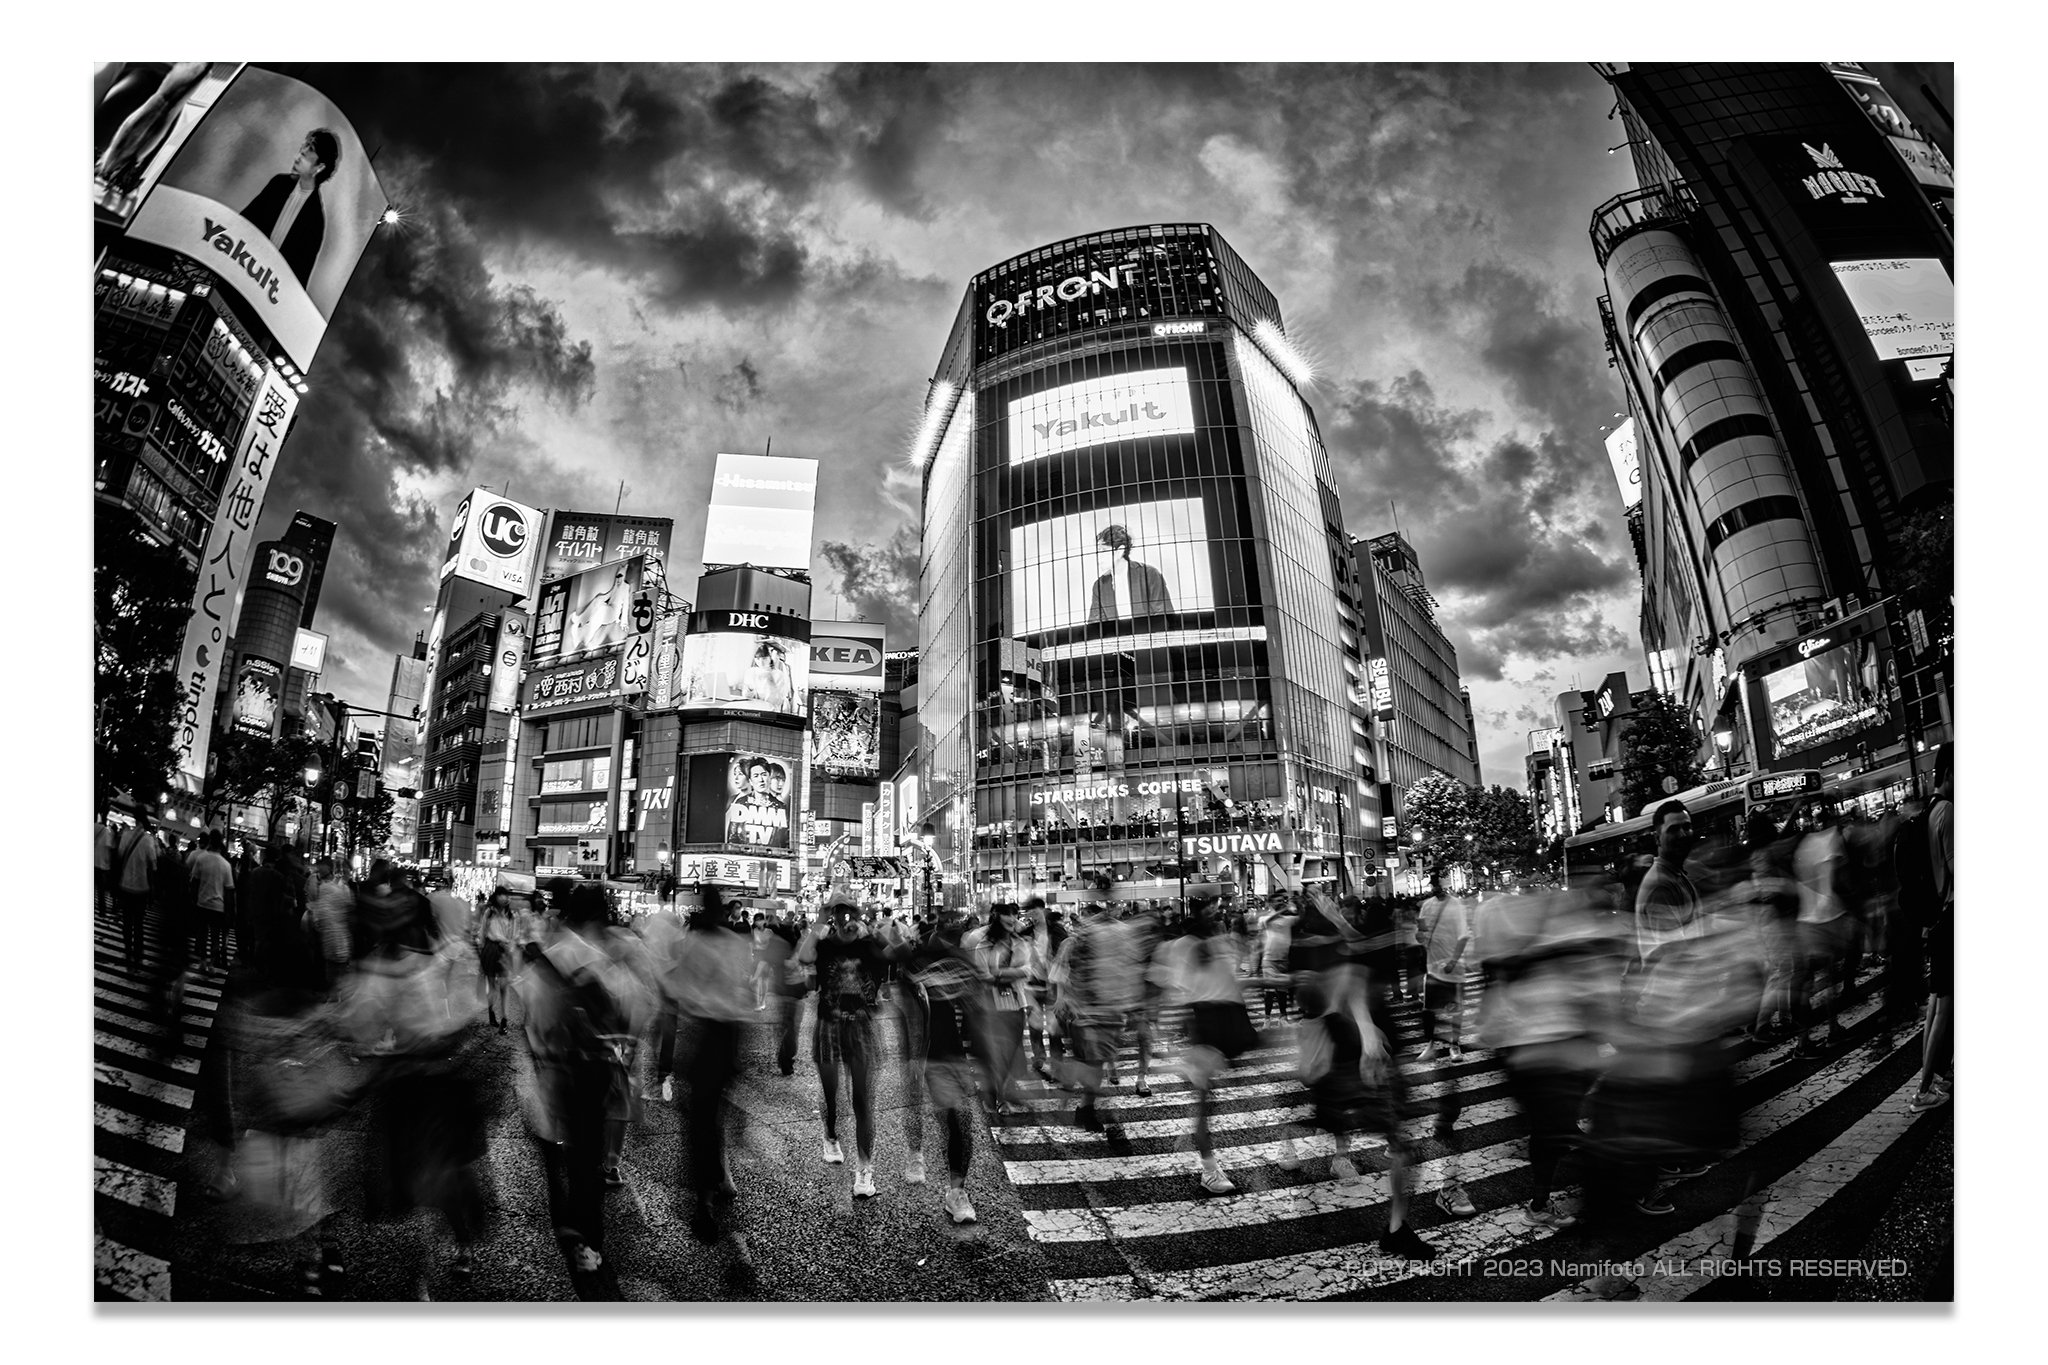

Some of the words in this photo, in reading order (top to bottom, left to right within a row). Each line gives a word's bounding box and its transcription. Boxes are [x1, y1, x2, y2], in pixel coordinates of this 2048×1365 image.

[1801, 170, 1886, 200] MAGNET
[201, 217, 280, 305] Yakult
[986, 263, 1139, 328] QFRONT
[1154, 322, 1204, 337] QFRONT
[109, 371, 151, 398] ガスト
[1032, 401, 1167, 439] Yakult
[196, 429, 229, 464] ガスト
[201, 385, 288, 644] 愛は他人と。
[561, 524, 600, 542] 龍角散
[621, 528, 661, 546] 龍角散
[555, 540, 603, 558] ダイレクト
[268, 547, 304, 586] 109
[502, 569, 523, 584] VISA
[728, 612, 769, 629] DHC
[624, 591, 655, 690] もんじゃ
[1798, 638, 1831, 658] Glico
[810, 646, 875, 664] KEA
[554, 676, 584, 696] 西村
[179, 671, 207, 758] tinder
[641, 787, 673, 810] クスリ
[1032, 783, 1130, 805] STARBUCKS
[1138, 778, 1202, 796] COFFEE
[729, 803, 788, 828] DMM
[1183, 832, 1283, 855] TSUTAYA
